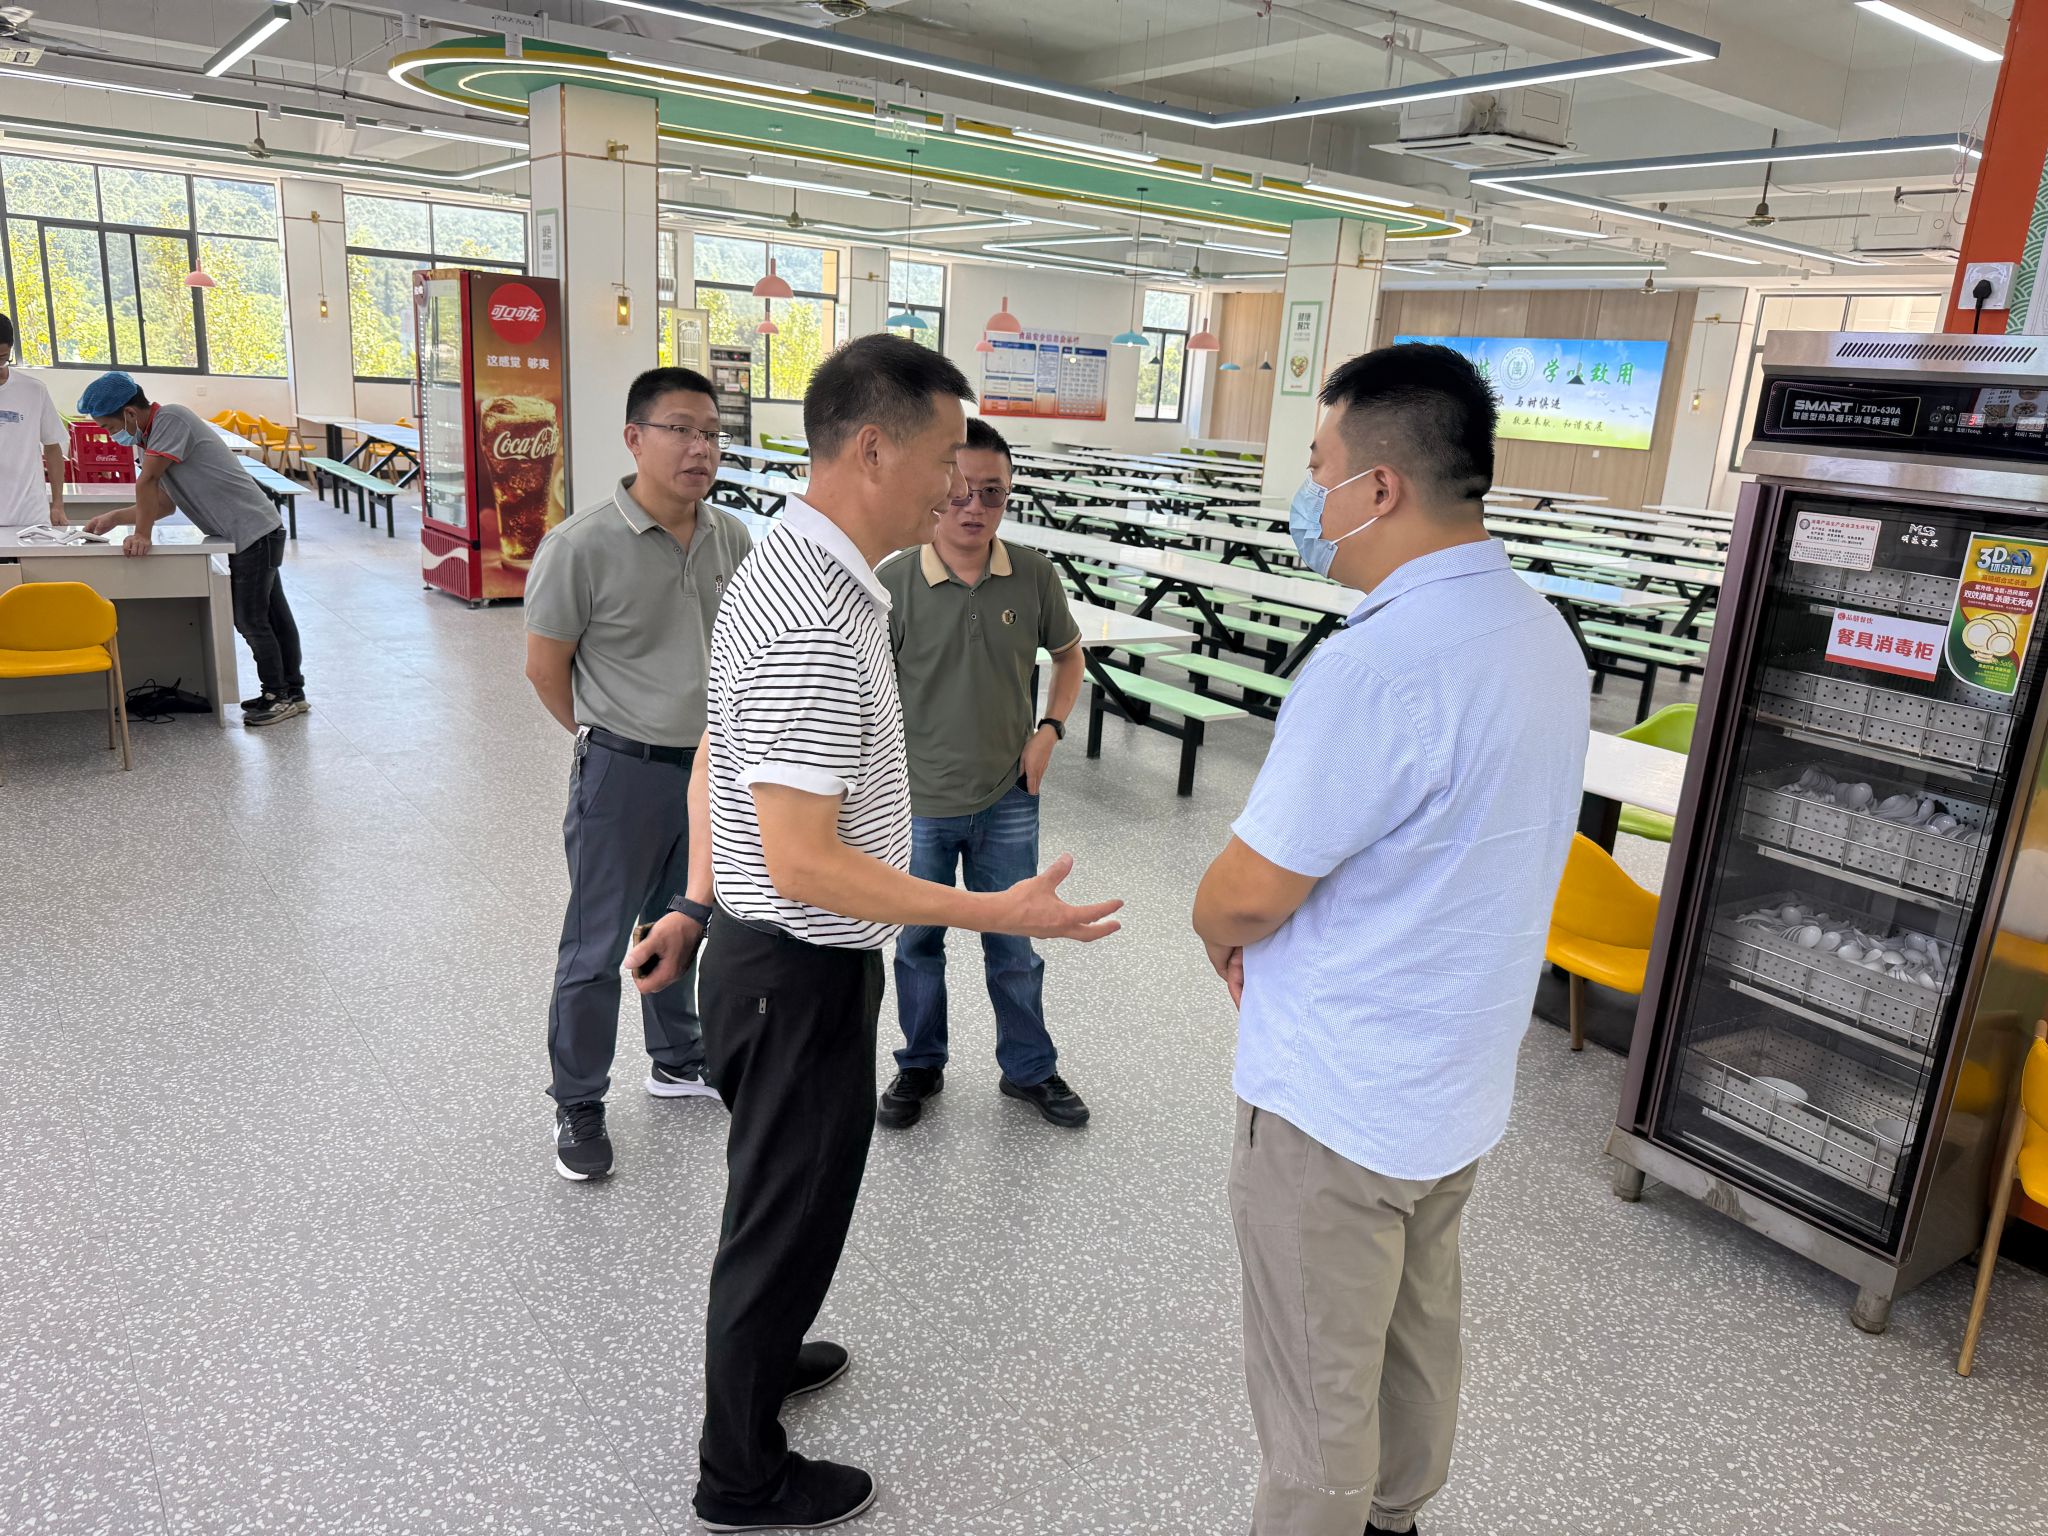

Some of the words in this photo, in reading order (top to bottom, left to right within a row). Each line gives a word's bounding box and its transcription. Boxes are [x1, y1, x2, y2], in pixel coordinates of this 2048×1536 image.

[491, 304, 541, 322] 可口可乐
[486, 355, 521, 368] 这感觉
[527, 357, 549, 369] 够爽
[1794, 400, 1854, 413] SMART
[1861, 405, 1901, 415] ZTD-630A
[1792, 411, 1900, 427] 智能型热风循环消毒保洁柜
[1994, 594, 2034, 608] 杀菌无死角
[1836, 627, 1934, 661] 餐具消毒柜
